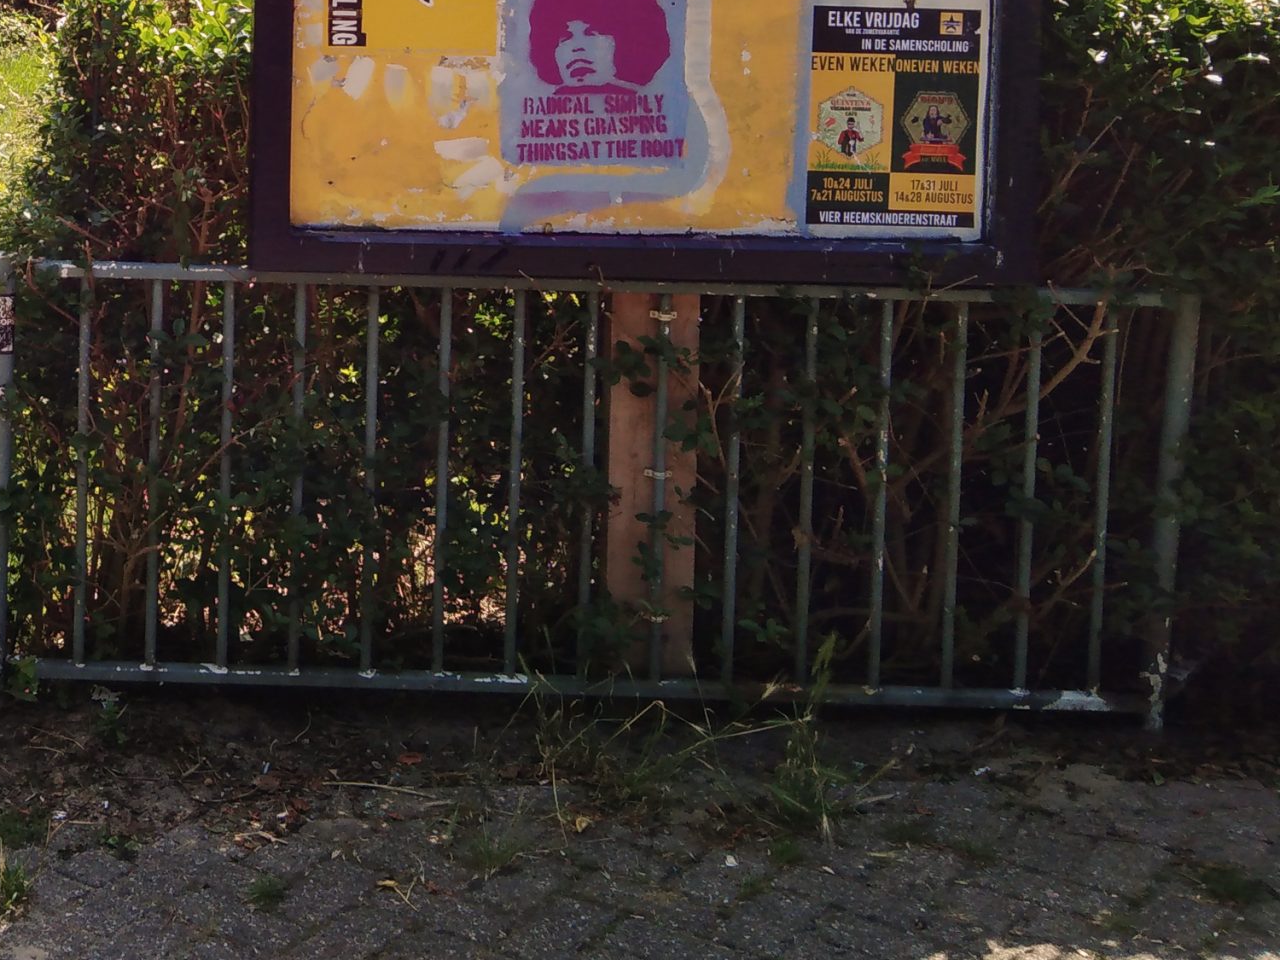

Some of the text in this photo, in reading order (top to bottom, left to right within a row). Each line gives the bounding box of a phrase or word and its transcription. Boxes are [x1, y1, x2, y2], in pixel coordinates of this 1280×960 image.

[828, 11, 919, 28] ELKE VRIJDAG
[862, 39, 969, 52] IN DE SAMENSCHOLING
[811, 55, 896, 72] EVEN WEKEN
[896, 58, 980, 74] ONEVEN WEKEN
[523, 94, 664, 115] RADICAL SIMPLY
[521, 115, 667, 138] MEANS GRASPING
[606, 139, 637, 158] THE
[641, 138, 685, 158] ROOT
[853, 178, 872, 189] JULI
[938, 180, 958, 191] JULI
[835, 190, 884, 202] AUGUSTUS
[925, 193, 973, 204] AUGUSTUS
[819, 211, 957, 226] VIER HEEMSKINDERENSTRAAT
